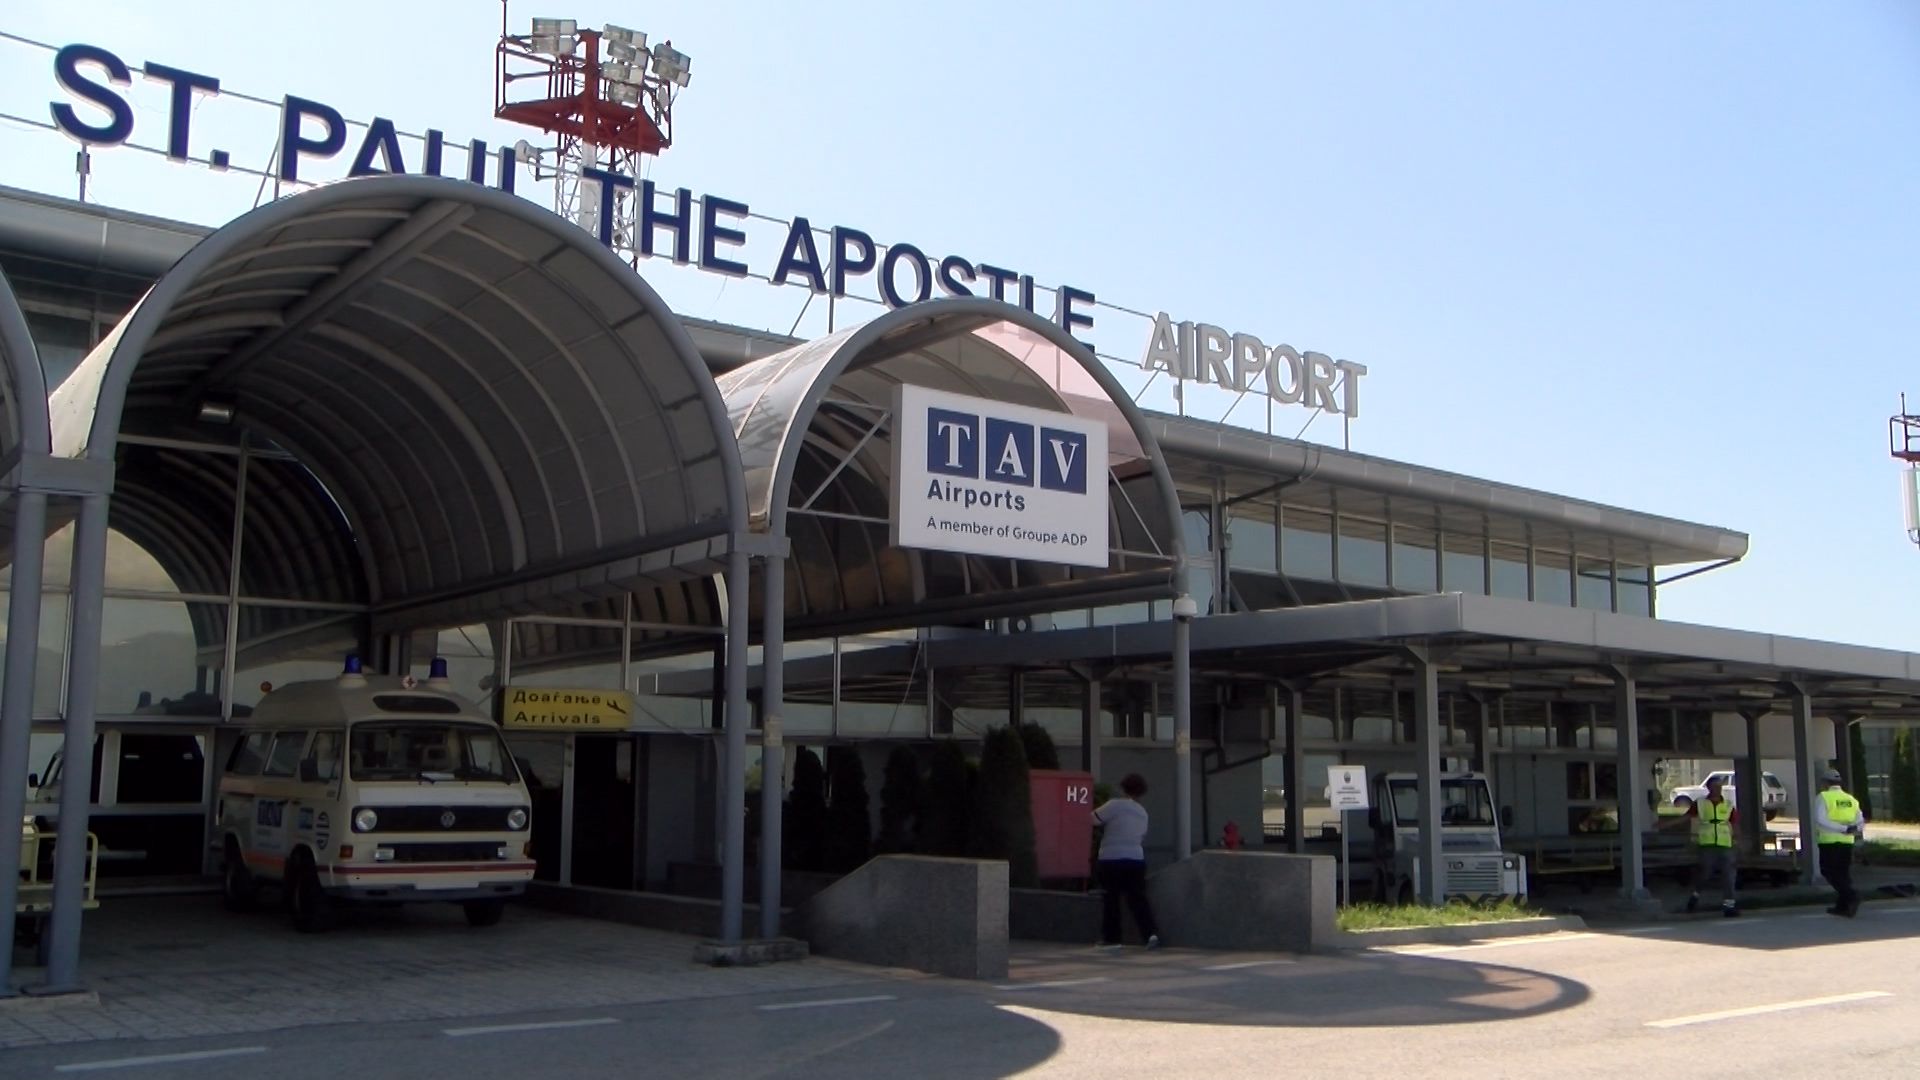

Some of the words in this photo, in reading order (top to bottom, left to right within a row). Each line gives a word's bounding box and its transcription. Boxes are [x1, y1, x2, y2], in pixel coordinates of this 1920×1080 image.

[50, 44, 229, 169] ST.
[583, 166, 749, 276] THE
[1142, 311, 1367, 418] AIRPORT
[937, 421, 1080, 484] TAV
[927, 479, 1026, 511] Airports
[927, 516, 937, 530] A
[940, 519, 993, 537] member
[996, 525, 1010, 538] of
[1013, 527, 1058, 544] Groupe
[1061, 533, 1088, 546] ADP
[514, 711, 601, 724] Arrivals
[1066, 785, 1089, 804] H2
